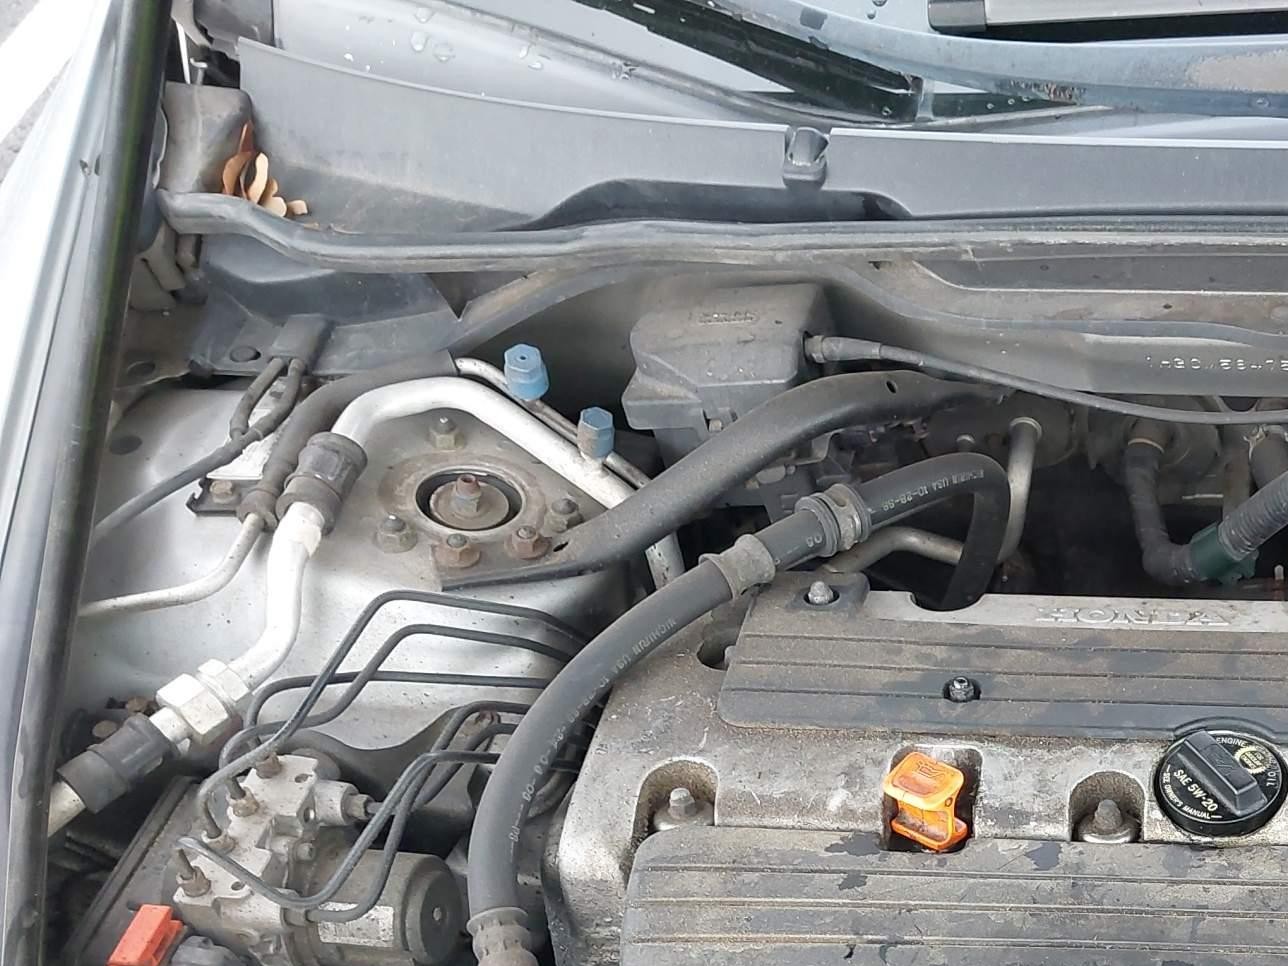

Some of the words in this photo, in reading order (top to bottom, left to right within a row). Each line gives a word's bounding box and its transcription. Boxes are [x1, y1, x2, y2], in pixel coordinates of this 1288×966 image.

[1035, 606, 1230, 627] HONDA
[1216, 736, 1247, 748] ENGINE
[1163, 784, 1184, 808] OWNER'S
[1182, 804, 1212, 820] MANUAL
[1173, 768, 1191, 786] SAE
[1187, 781, 1219, 812] 5W-20
